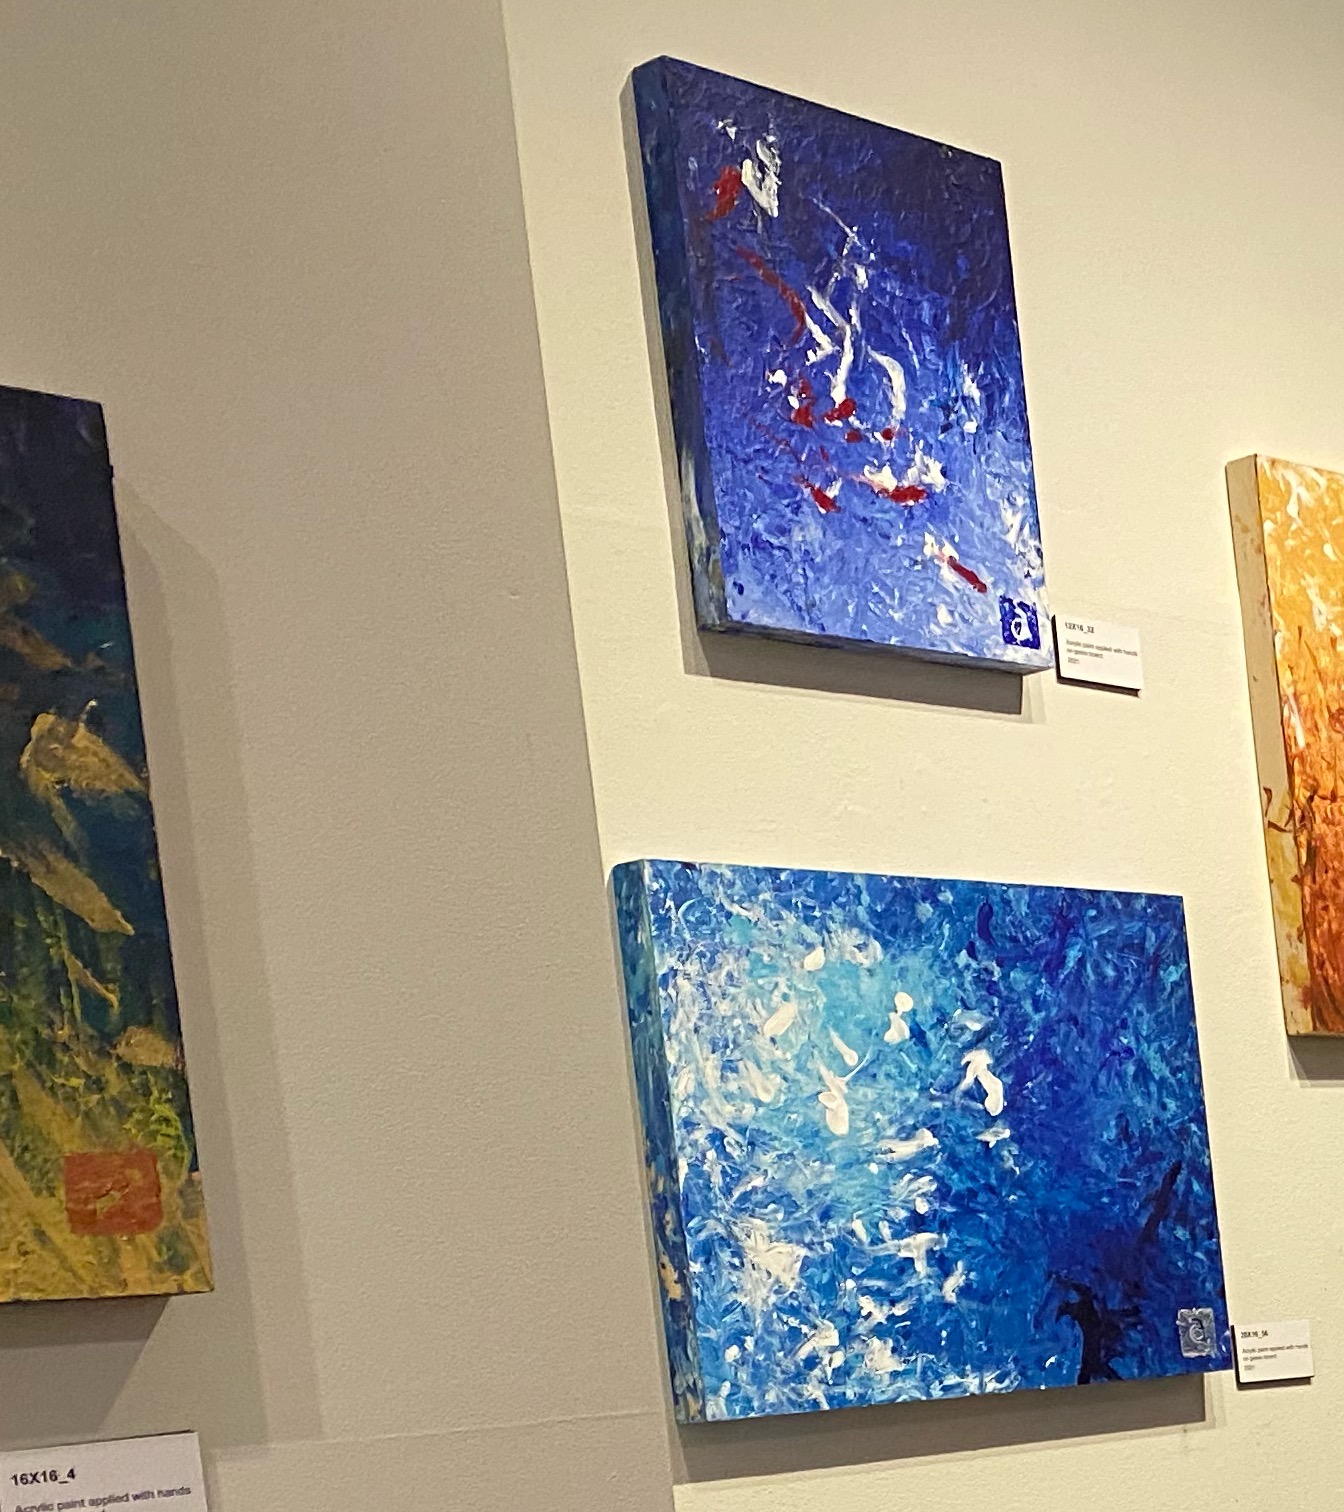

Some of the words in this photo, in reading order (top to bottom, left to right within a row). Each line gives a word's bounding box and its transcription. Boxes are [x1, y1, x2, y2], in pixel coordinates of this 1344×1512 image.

[10, 1468, 76, 1486] 16X16_4
[56, 1499, 86, 1512] paint
[88, 1492, 130, 1508] applied
[131, 1489, 155, 1502] with
[156, 1486, 192, 1499] hands
